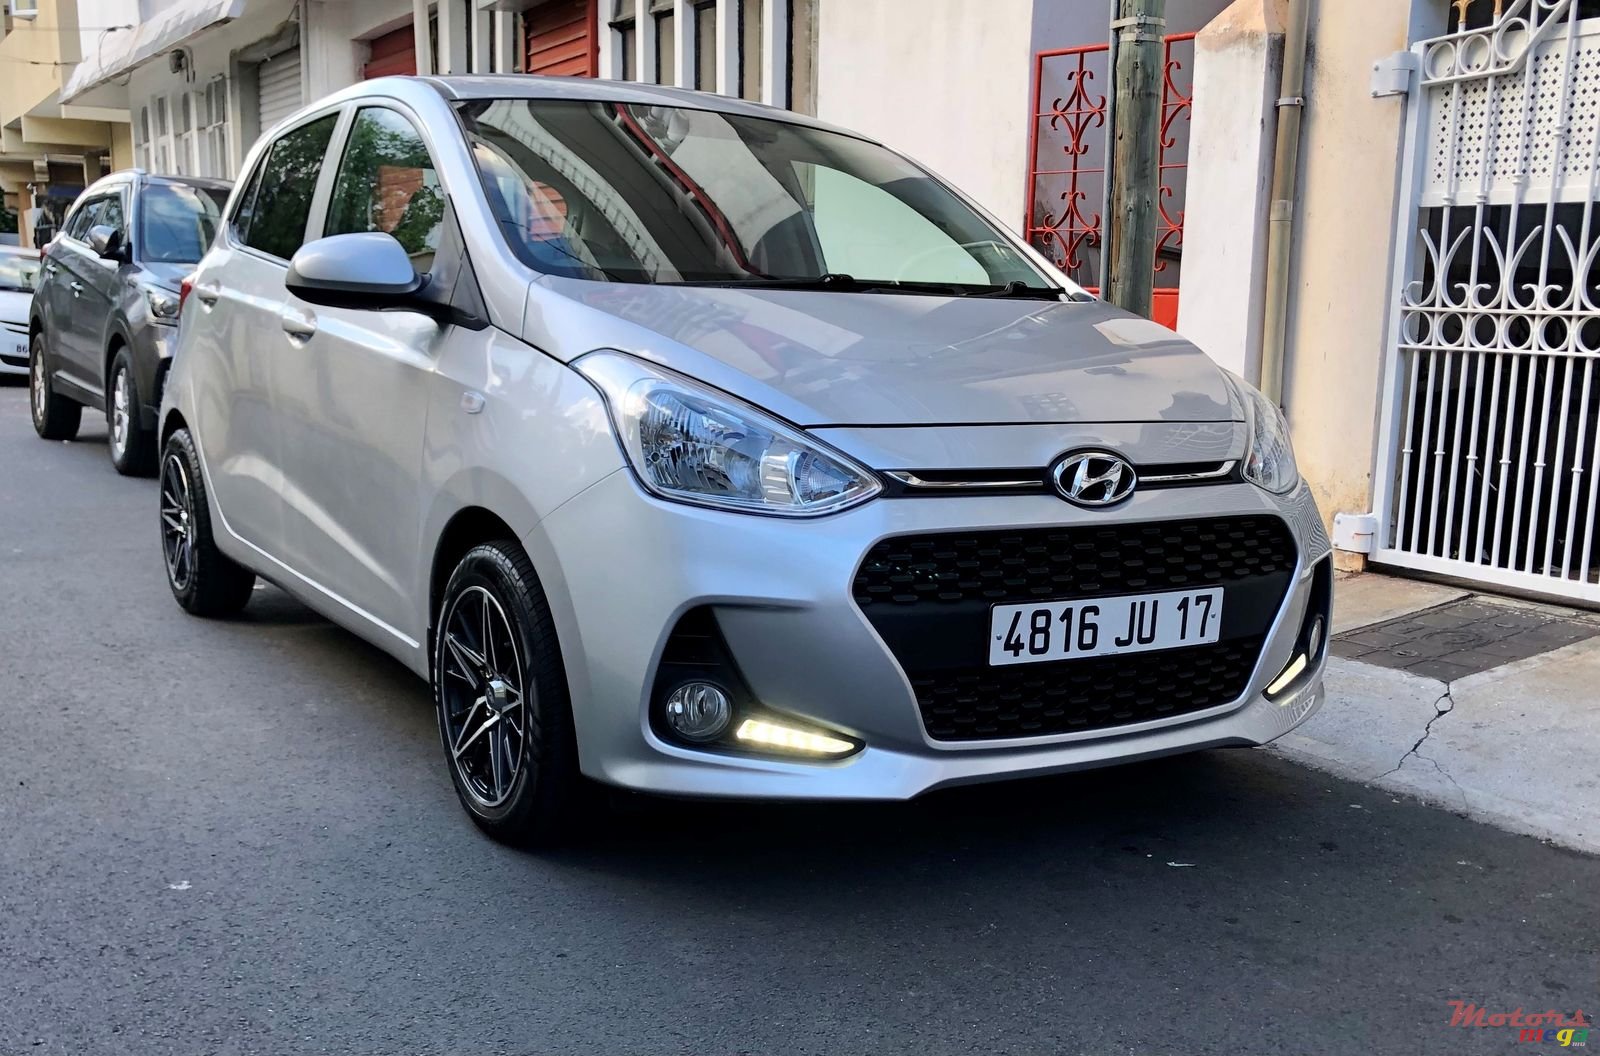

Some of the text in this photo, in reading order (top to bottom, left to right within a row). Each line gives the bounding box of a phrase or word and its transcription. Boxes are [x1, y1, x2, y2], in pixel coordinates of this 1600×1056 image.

[1003, 594, 1213, 657] 4816 JU 17
